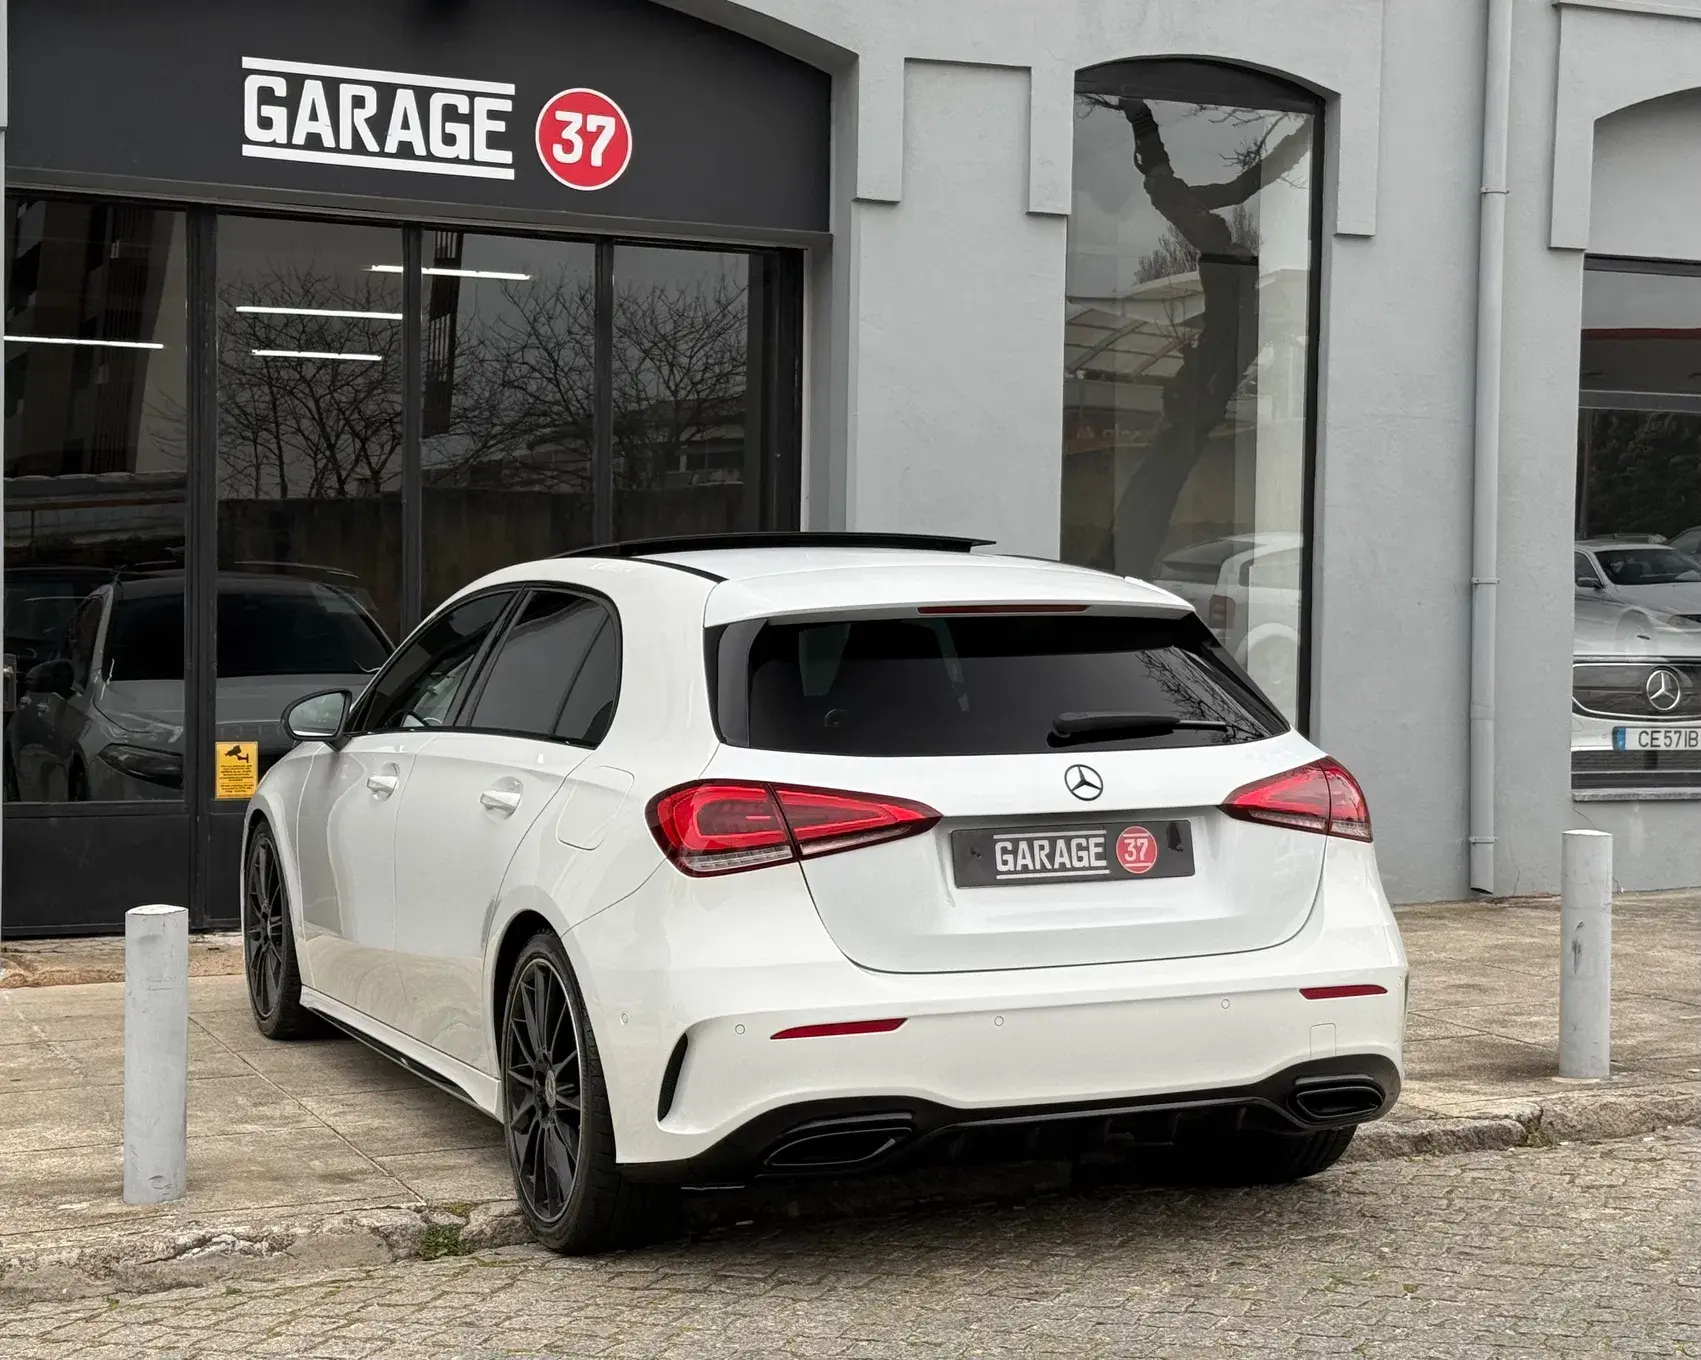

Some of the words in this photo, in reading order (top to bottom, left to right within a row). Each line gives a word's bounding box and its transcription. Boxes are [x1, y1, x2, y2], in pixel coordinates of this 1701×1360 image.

[243, 74, 513, 165] GARAGE
[551, 110, 616, 167] 37
[994, 836, 1107, 872] GARAGE
[1124, 838, 1149, 862] 37
